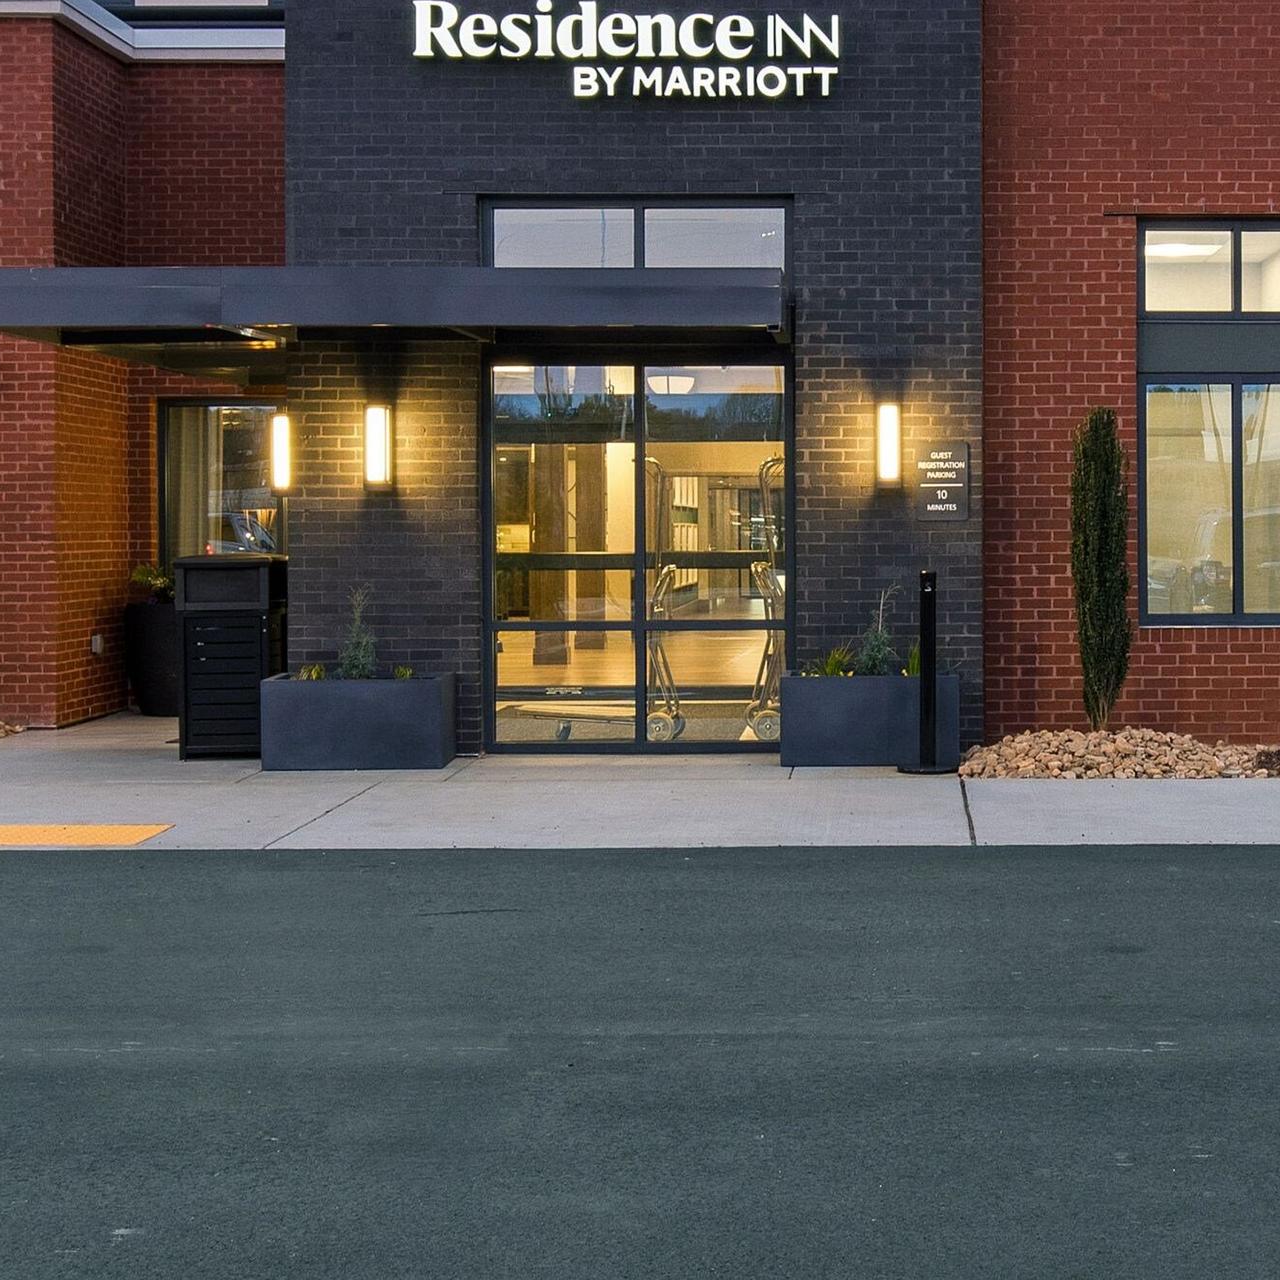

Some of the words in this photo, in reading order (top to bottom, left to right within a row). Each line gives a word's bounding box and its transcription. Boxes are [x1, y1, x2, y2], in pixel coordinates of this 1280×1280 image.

[767, 13, 840, 58] INN
[573, 66, 625, 97] BY
[632, 66, 838, 98] MARRIOTT
[918, 461, 965, 469] REGISTRATION
[936, 490, 948, 499] 10
[927, 503, 957, 511] MINUTES
